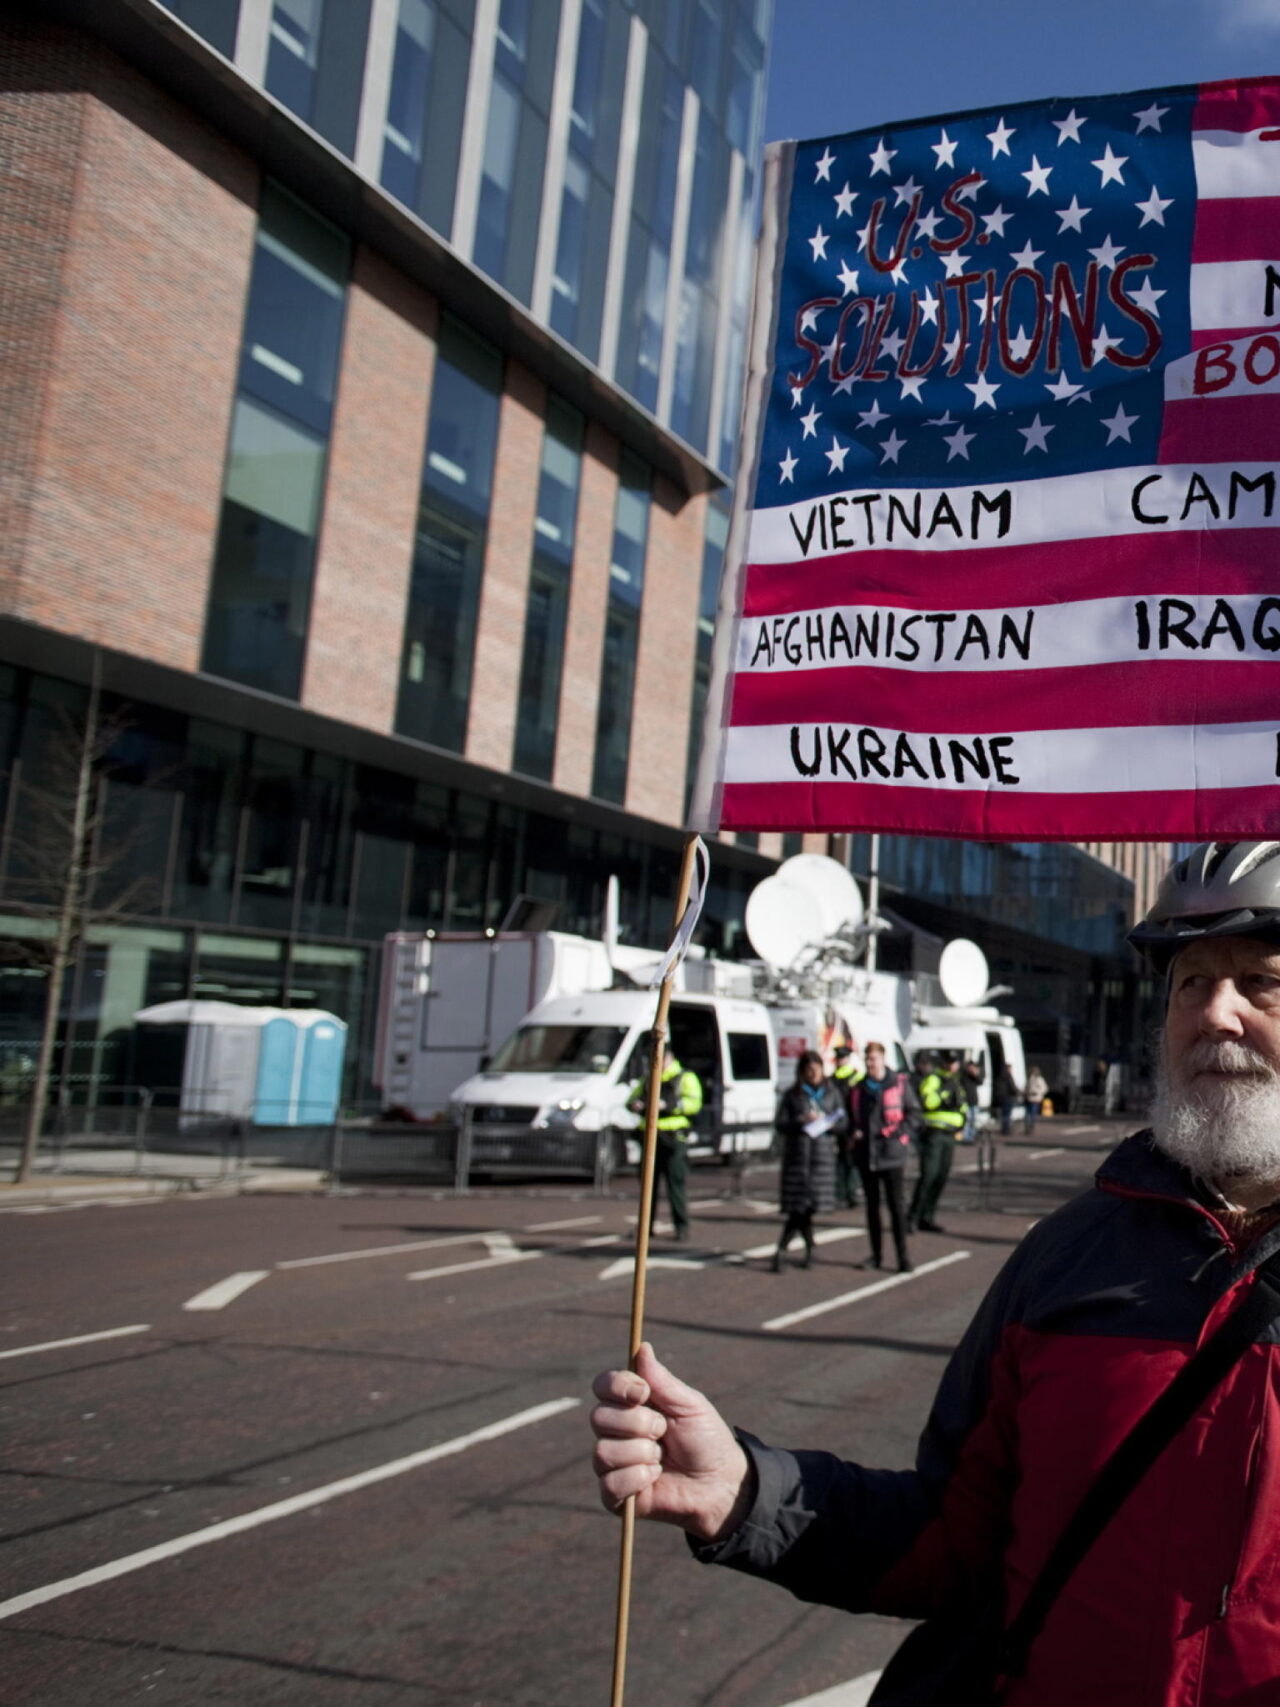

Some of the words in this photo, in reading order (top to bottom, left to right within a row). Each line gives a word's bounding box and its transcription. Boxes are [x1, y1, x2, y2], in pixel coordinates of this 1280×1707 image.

[864, 171, 990, 274] U.S.
[788, 252, 1163, 390] SOLUTIONS
[789, 489, 1012, 556] VIETNAM
[750, 609, 1034, 667] AFGHANISTAN
[789, 725, 1020, 784] UKRAINE
